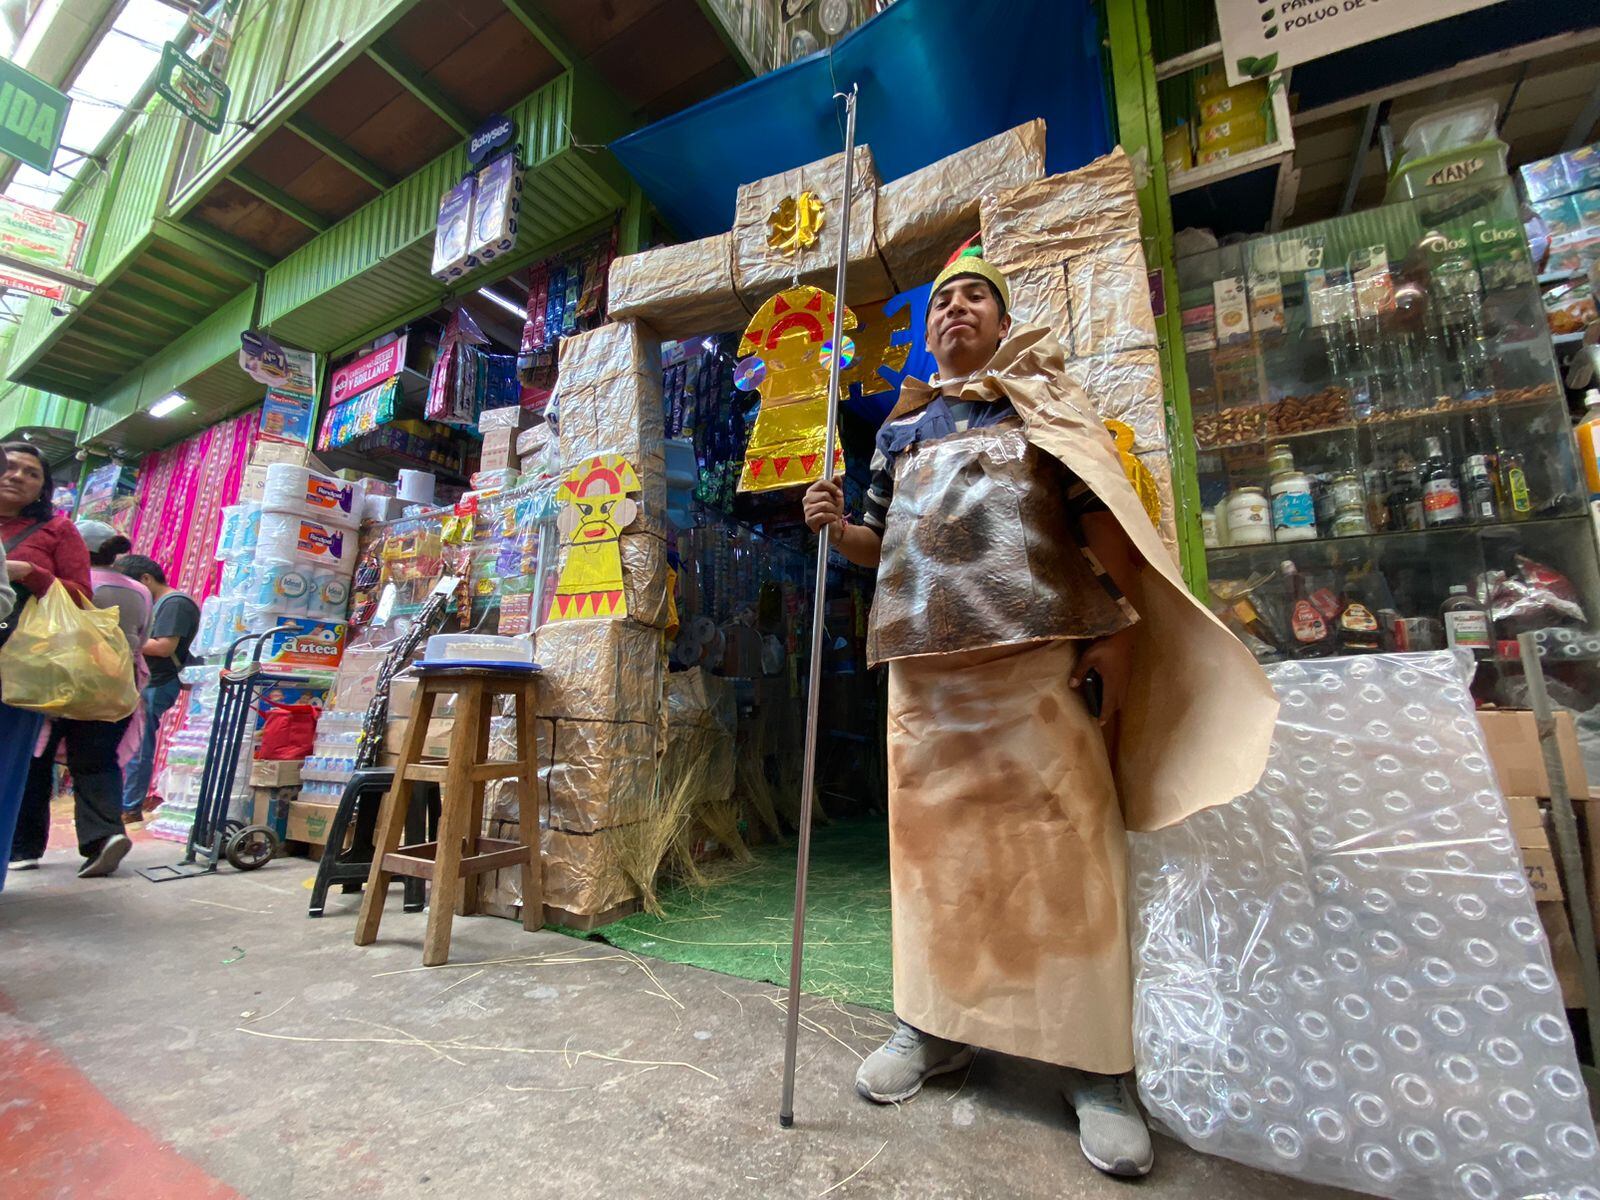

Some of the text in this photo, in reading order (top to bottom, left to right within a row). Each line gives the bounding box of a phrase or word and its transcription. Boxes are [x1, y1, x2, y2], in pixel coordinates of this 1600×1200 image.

[1284, 6, 1338, 32] POLVO
[470, 121, 509, 153] Babysec
[1431, 238, 1468, 253] Clos
[1479, 228, 1518, 244] Clos
[281, 635, 338, 656] azteca
